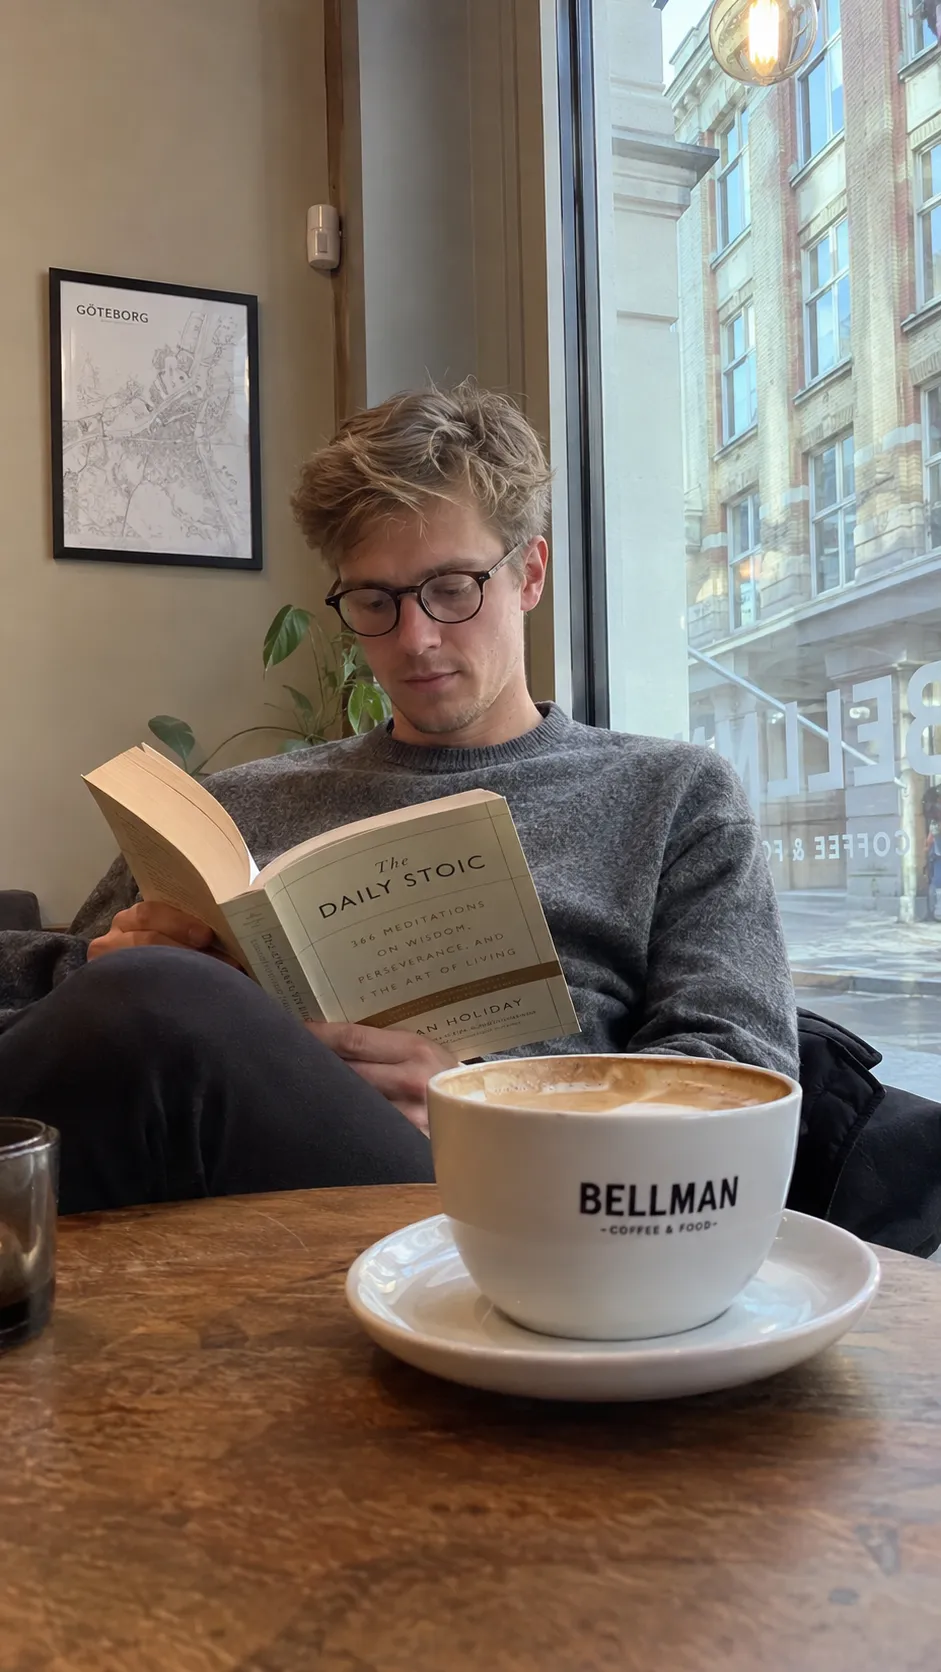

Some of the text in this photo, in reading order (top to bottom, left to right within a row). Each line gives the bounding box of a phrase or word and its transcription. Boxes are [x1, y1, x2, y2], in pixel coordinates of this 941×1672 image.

[76, 303, 149, 323] GÖTEBORG
[375, 856, 409, 874] The
[318, 855, 485, 919] DAILY STOIC
[351, 900, 486, 948] 366 MEDITATIONS
[377, 945, 399, 958] ON
[475, 932, 505, 947] AND
[371, 983, 398, 997] THE
[405, 971, 432, 986] ART
[440, 964, 458, 975] OF
[465, 947, 517, 967] LIVING
[416, 1023, 438, 1036] AN
[446, 998, 523, 1027] HOLIDAY
[579, 1175, 739, 1217] BELLMAN
[665, 1224, 674, 1235] &
